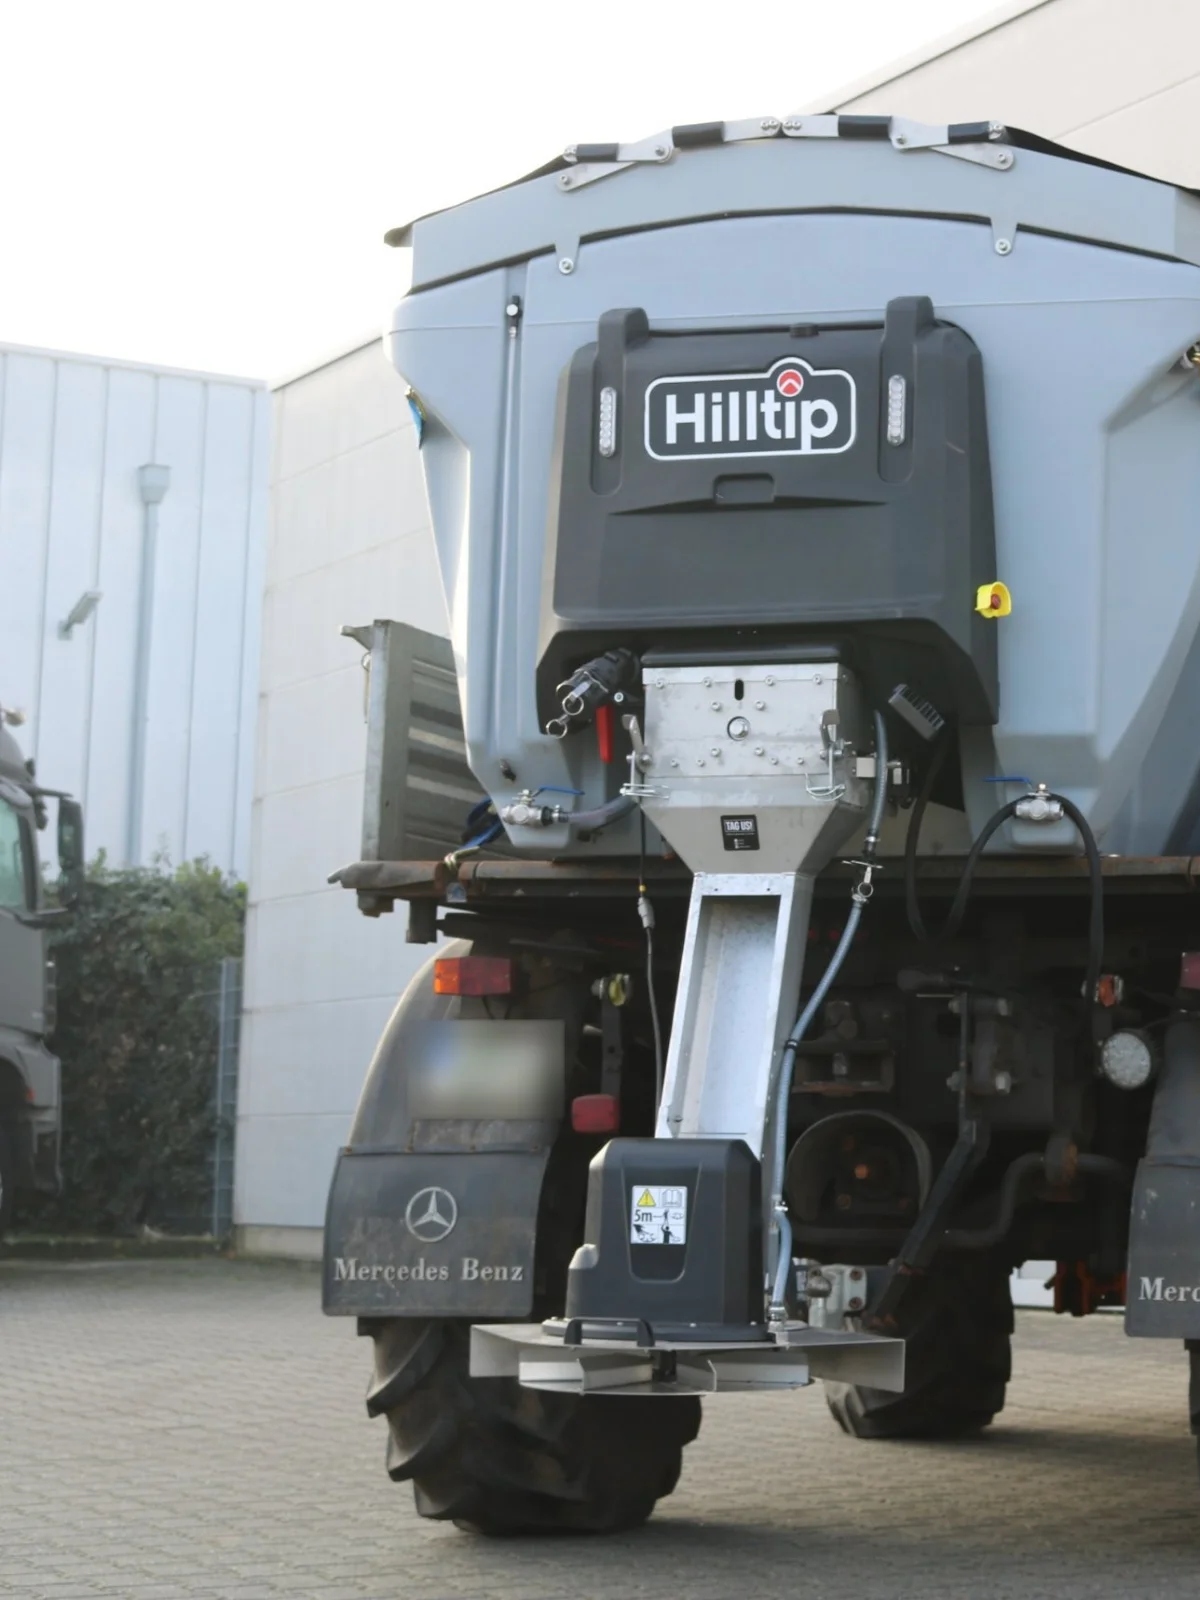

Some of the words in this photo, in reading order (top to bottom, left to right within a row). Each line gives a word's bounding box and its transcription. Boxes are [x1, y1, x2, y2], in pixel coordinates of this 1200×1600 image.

[666, 369, 838, 450] Hilltip
[725, 821, 740, 831] TAG
[634, 1209, 653, 1222] 5m
[333, 1257, 449, 1281] Mercedes
[460, 1257, 523, 1281] Benz
